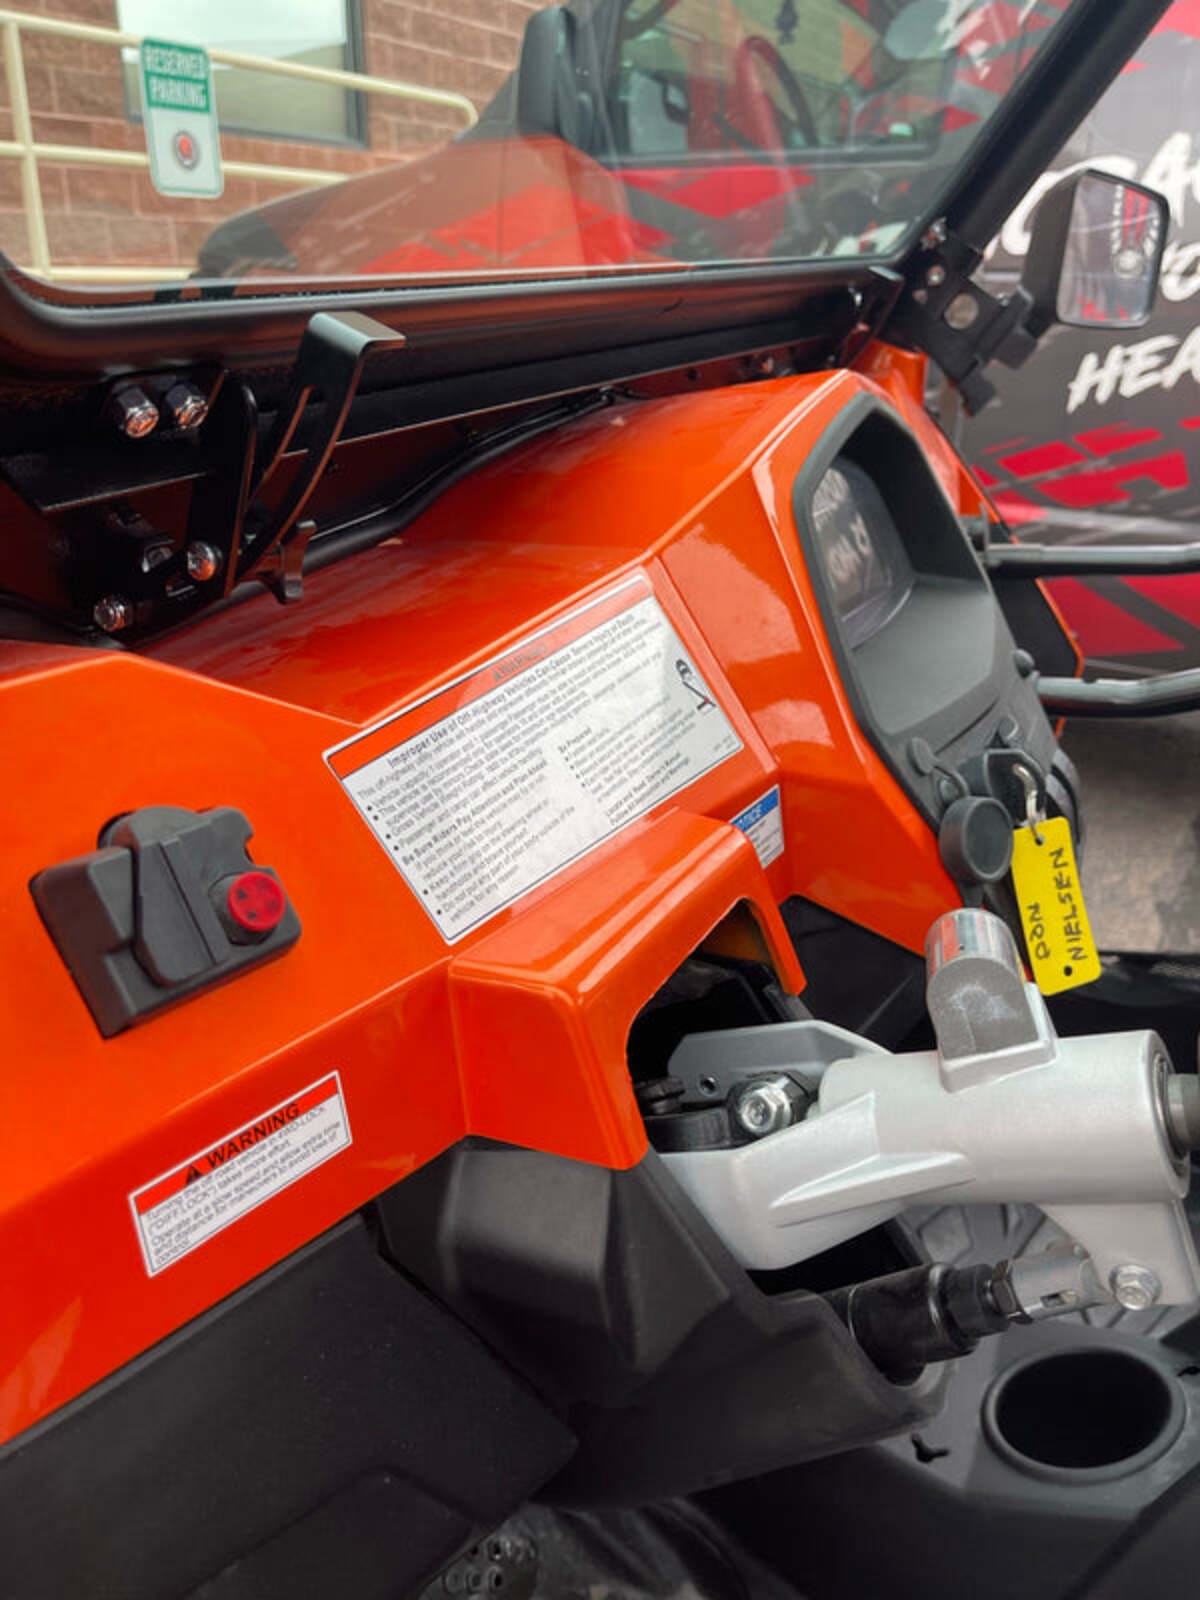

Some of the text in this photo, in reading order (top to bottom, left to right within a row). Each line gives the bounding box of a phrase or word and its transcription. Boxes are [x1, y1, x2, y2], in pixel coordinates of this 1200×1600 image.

[144, 45, 207, 78] RESERVED
[150, 78, 207, 107] PARKING
[386, 735, 431, 768] Improper
[428, 725, 448, 743] Use
[1050, 848, 1087, 961] NIELSEN
[1027, 902, 1050, 961] DON
[207, 1103, 297, 1170] WARNING
